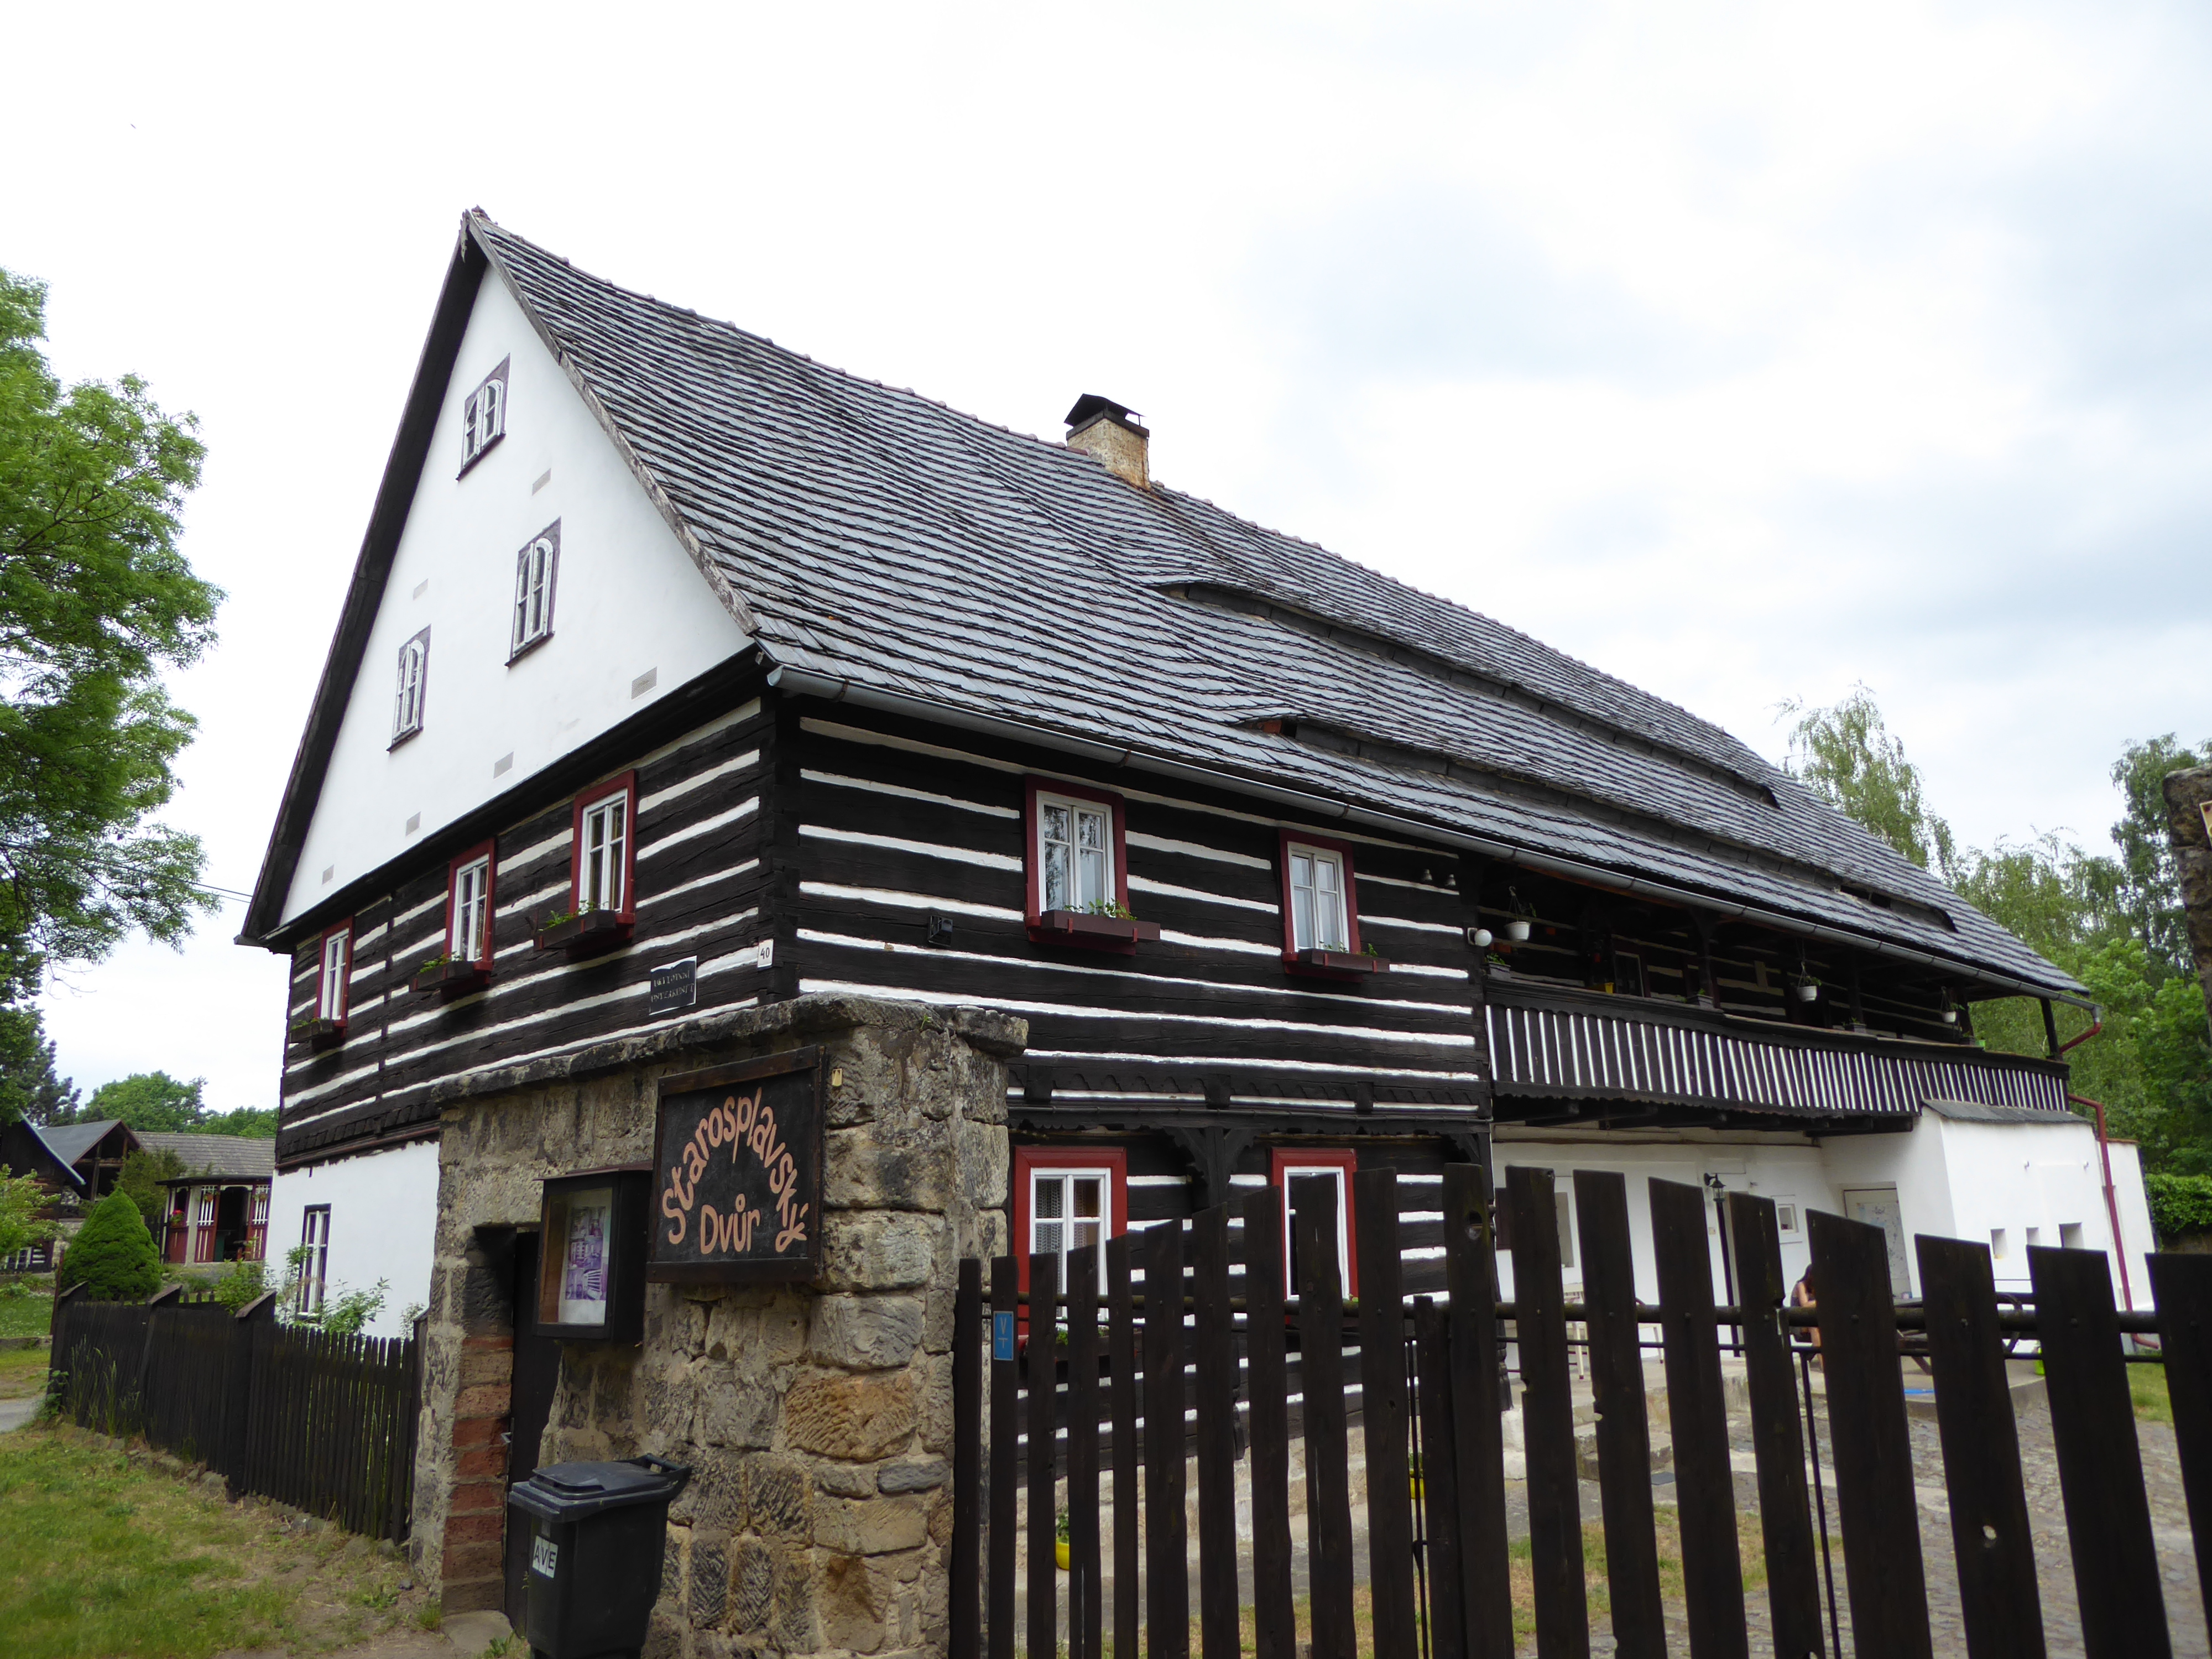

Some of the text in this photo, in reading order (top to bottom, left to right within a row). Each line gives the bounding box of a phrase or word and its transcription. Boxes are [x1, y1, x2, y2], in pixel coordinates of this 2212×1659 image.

[760, 947, 770, 959] 40
[662, 1087, 808, 1253] Starosplavský
[700, 1193, 761, 1255] Dvůr
[534, 1545, 556, 1571] AVE
